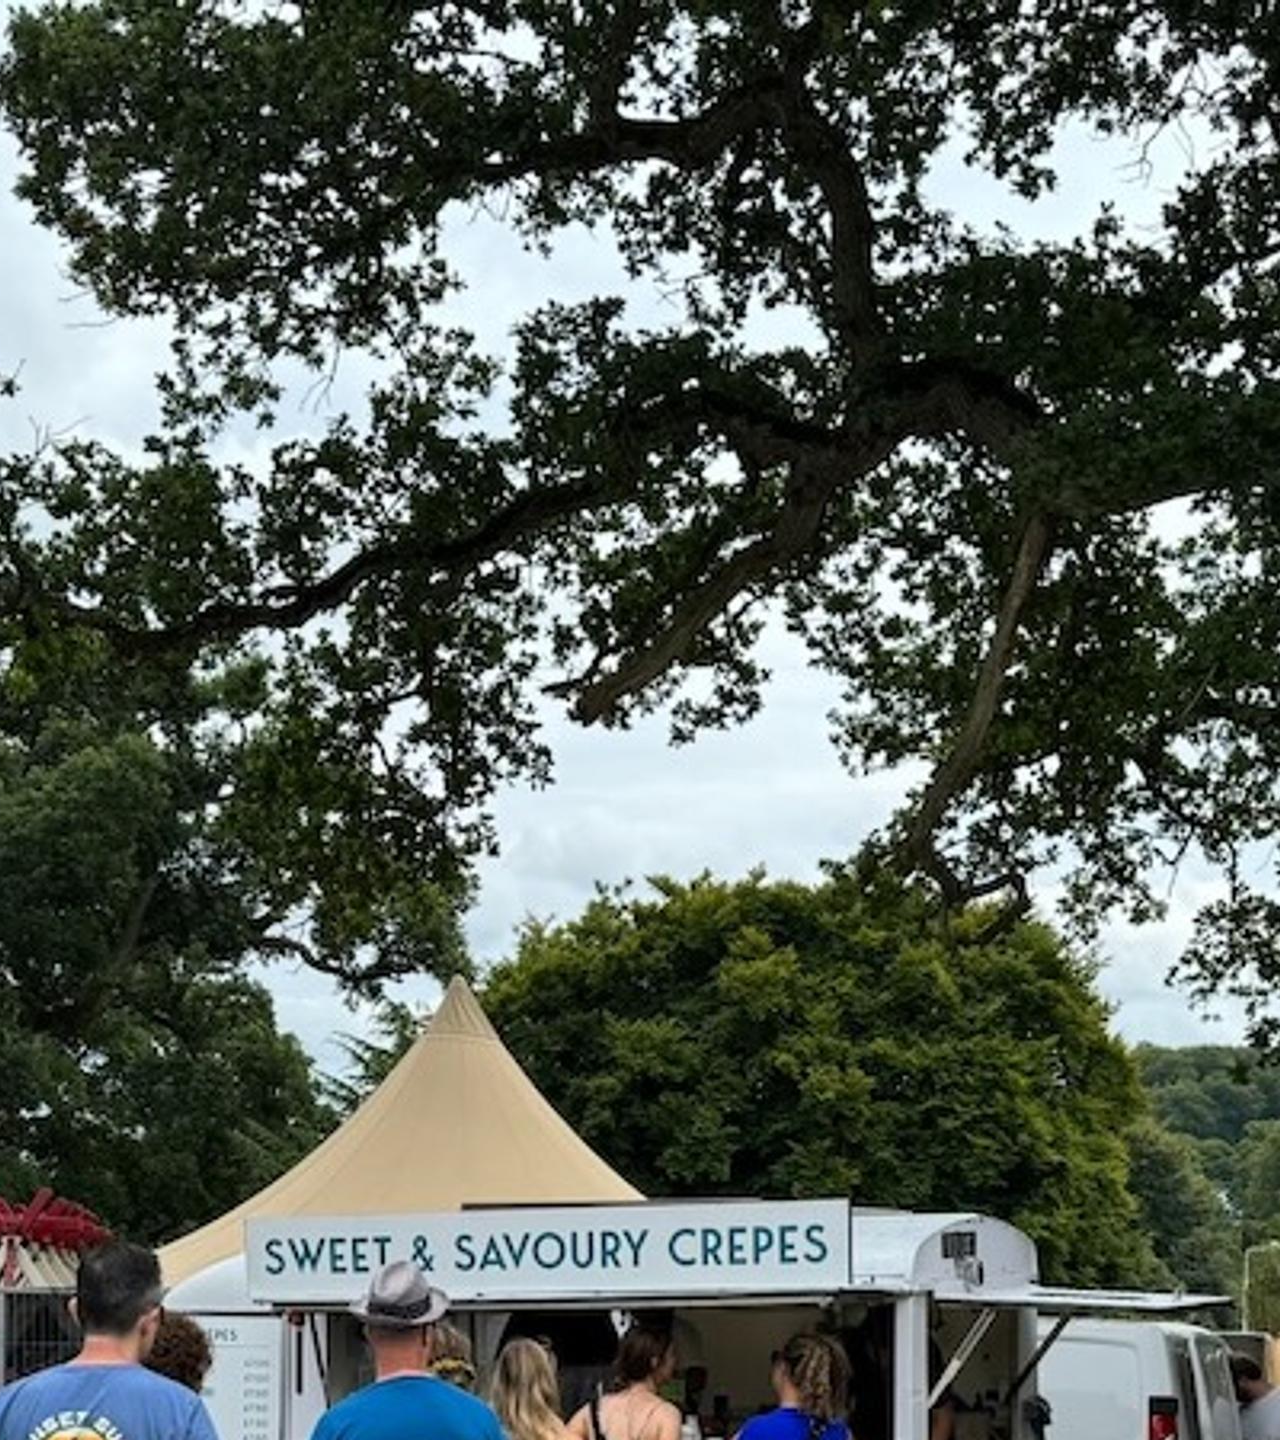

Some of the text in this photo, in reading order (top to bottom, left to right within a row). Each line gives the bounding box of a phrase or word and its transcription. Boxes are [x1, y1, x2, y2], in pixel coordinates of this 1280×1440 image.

[265, 1224, 828, 1275] SWEET & SAVOURY CREPES
